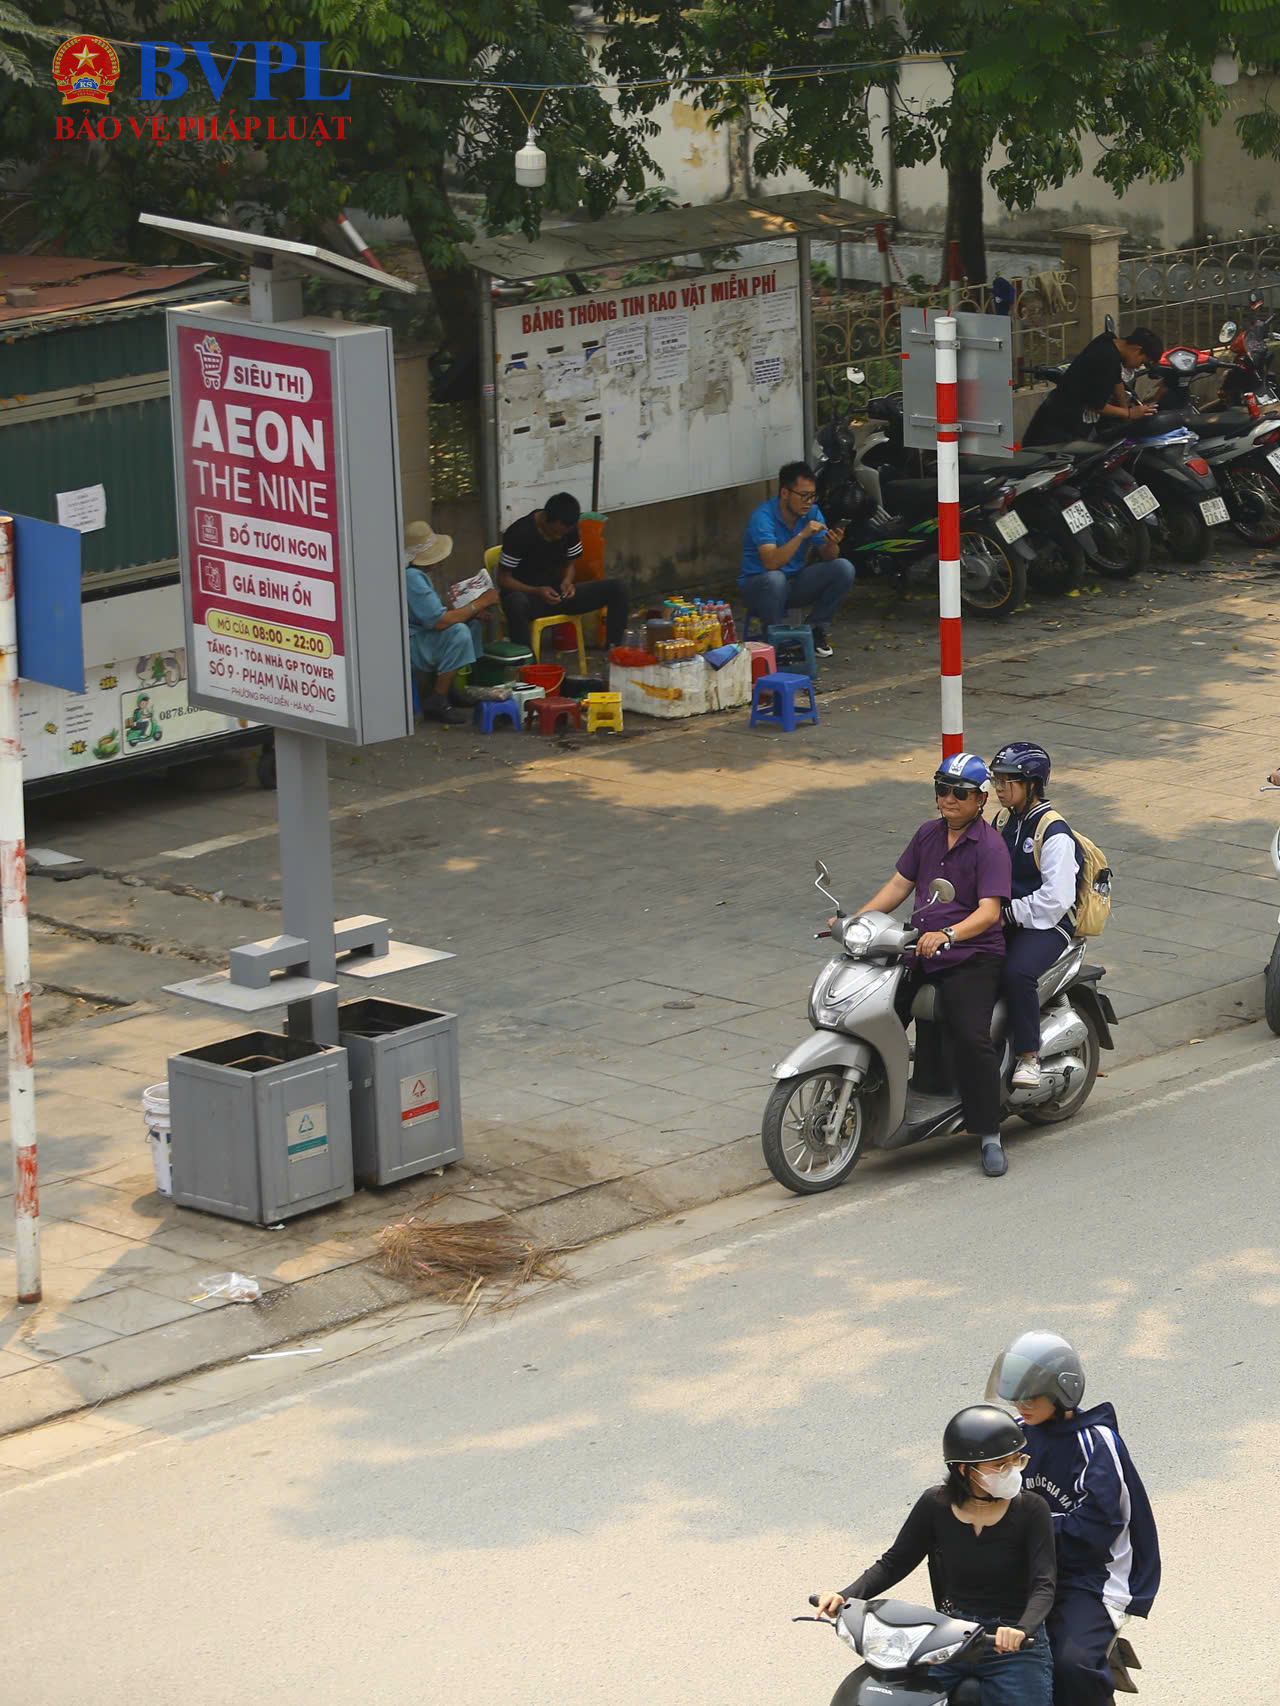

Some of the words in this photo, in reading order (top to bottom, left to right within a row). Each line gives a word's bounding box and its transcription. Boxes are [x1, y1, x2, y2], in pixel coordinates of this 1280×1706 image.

[522, 305, 564, 334] BẢNG
[568, 299, 617, 326] THÔNG
[621, 296, 644, 317] TIN
[648, 290, 677, 312] RAO
[681, 283, 706, 311] VẶT
[711, 274, 748, 302] MIỄN
[752, 269, 776, 295] PHÍ
[234, 364, 272, 389] SIÊU
[275, 372, 304, 399] THỊ
[192, 399, 325, 471] AEON
[193, 460, 252, 504] THE
[259, 472, 328, 519] NINE
[230, 523, 250, 546] ĐỒ
[253, 531, 285, 553] TƯƠI
[288, 538, 327, 561] NGON
[232, 574, 255, 595] GIÁ
[259, 578, 289, 602] BÌNH
[292, 581, 312, 607] ỔN
[217, 617, 231, 632] MỞ
[252, 625, 283, 644] 08:00
[293, 634, 324, 653] 22:00
[207, 638, 232, 656] TẦNG
[234, 647, 238, 658] 1
[245, 648, 263, 663] TÒA
[265, 653, 284, 668] NHÀ
[286, 659, 299, 672] GP
[300, 662, 334, 680] TOWER
[209, 658, 225, 677] SỐ
[227, 665, 234, 679] 9
[242, 668, 274, 689] PHẠM
[276, 674, 299, 694] VĂN
[301, 680, 336, 702] ĐỒNG
[159, 706, 203, 720] 0878.6
